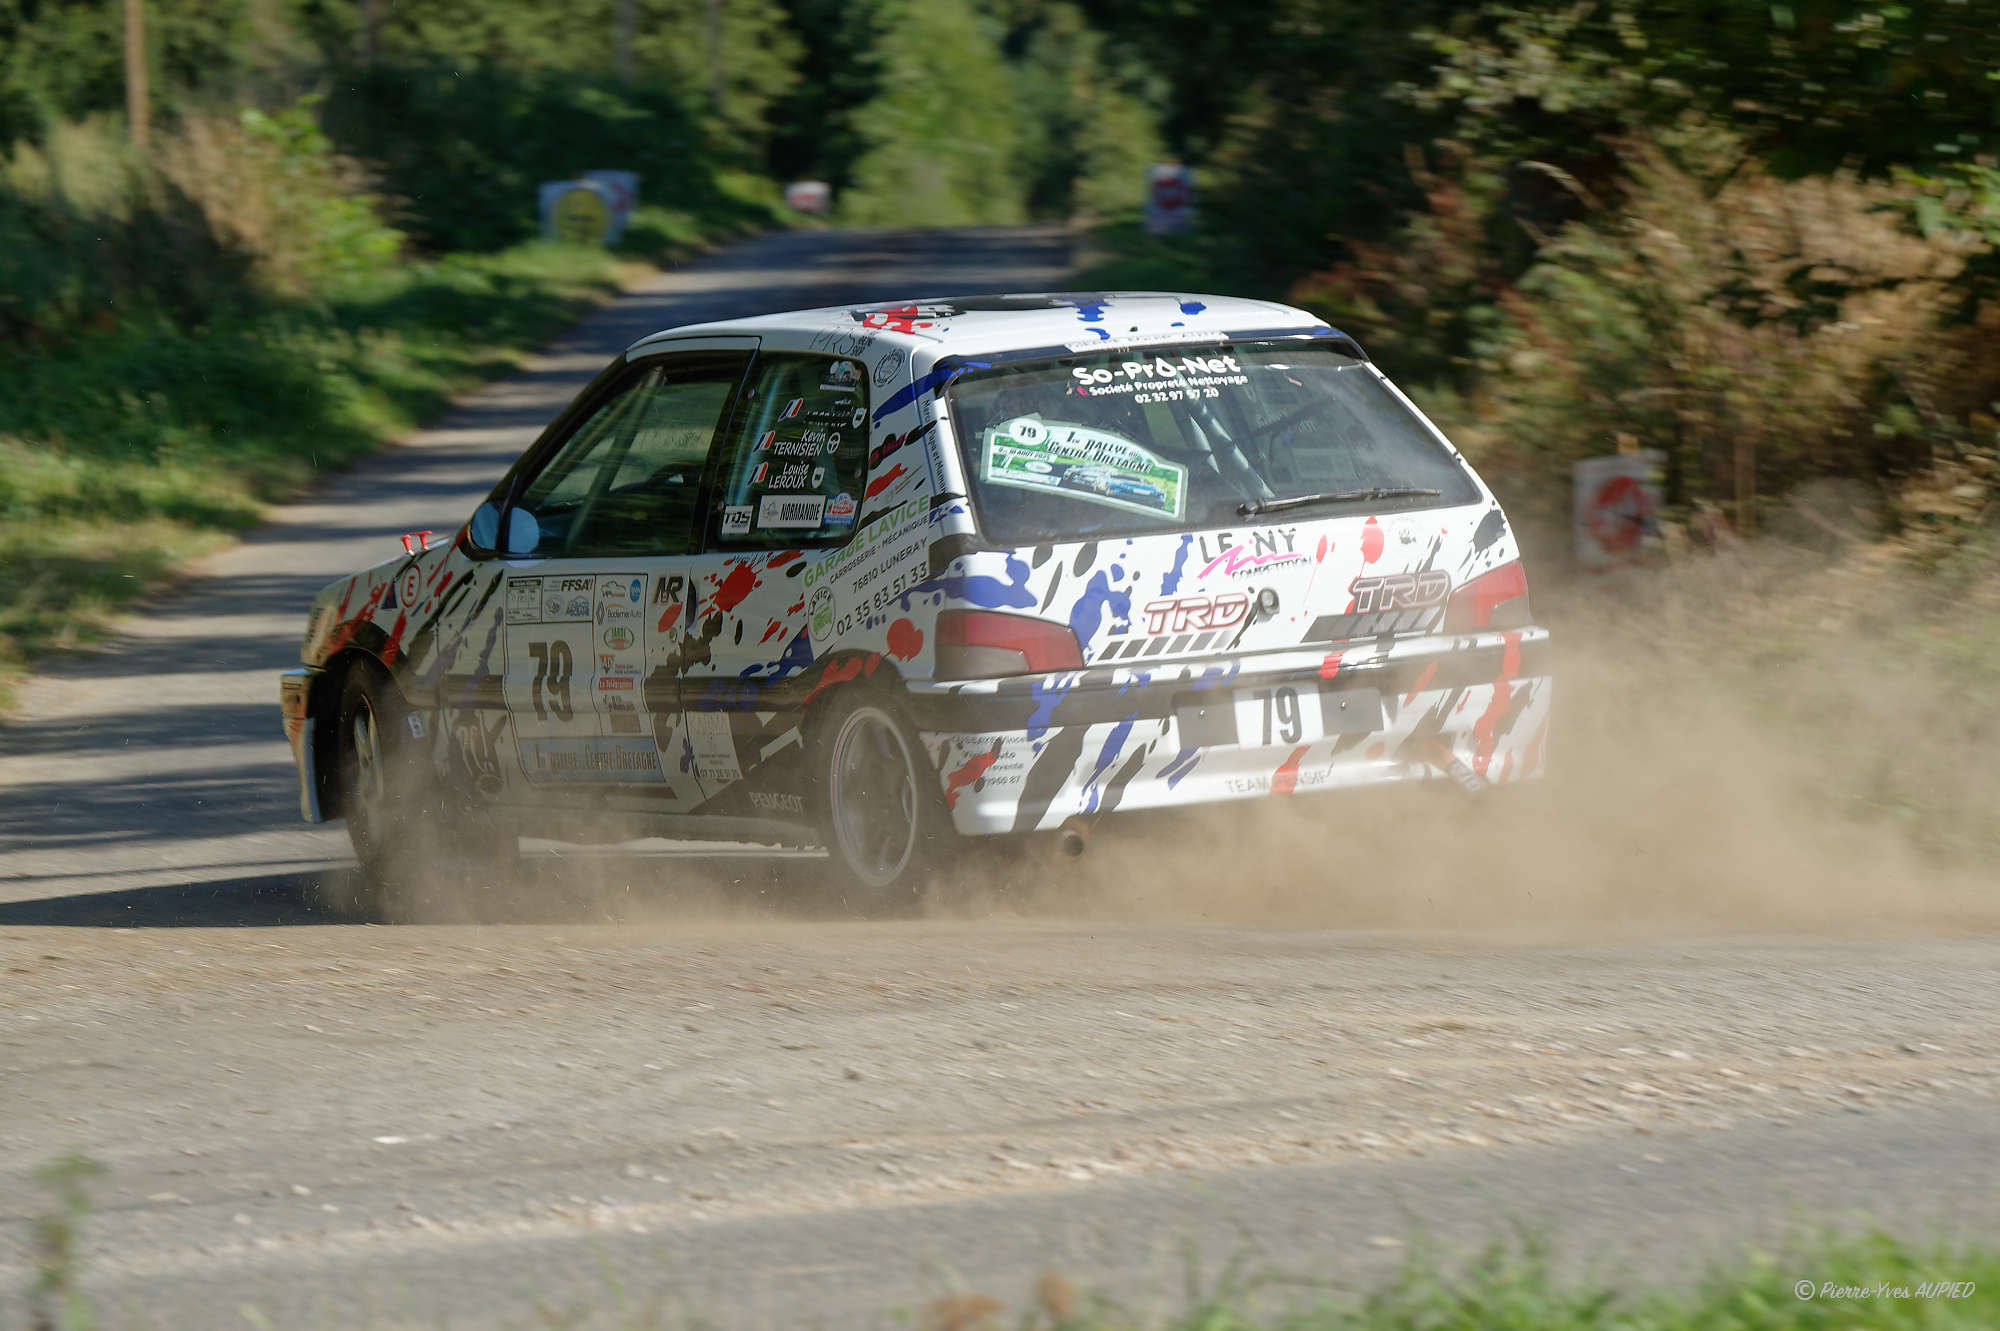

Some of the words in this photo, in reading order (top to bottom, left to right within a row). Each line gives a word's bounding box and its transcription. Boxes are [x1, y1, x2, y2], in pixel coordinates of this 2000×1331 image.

[1135, 393, 1152, 405] 02
[1154, 391, 1169, 403] 32
[1170, 389, 1184, 401] 97
[1203, 387, 1220, 399] 20
[1019, 425, 1037, 439] 79
[773, 441, 824, 457] TERNISIEN
[783, 460, 810, 476] Louise
[768, 475, 808, 489] LEROUX
[779, 503, 821, 521] NORMANDIE
[803, 530, 864, 588] GARAGE
[868, 494, 929, 543] LAVICE
[1252, 527, 1296, 557] NY
[880, 536, 928, 574] LUNERAY
[407, 575, 415, 597] E
[560, 578, 590, 593] FFSA
[1351, 569, 1452, 614] TRD
[836, 614, 852, 636] 02
[855, 599, 871, 622] 35
[874, 585, 889, 610] 83
[892, 575, 907, 595] 51
[910, 561, 928, 584] 33
[1144, 592, 1250, 635] TRD
[528, 640, 574, 722] 79
[1260, 685, 1304, 745] 79
[1224, 777, 1268, 794] TEAM
[749, 791, 804, 814] PEUGEOT
